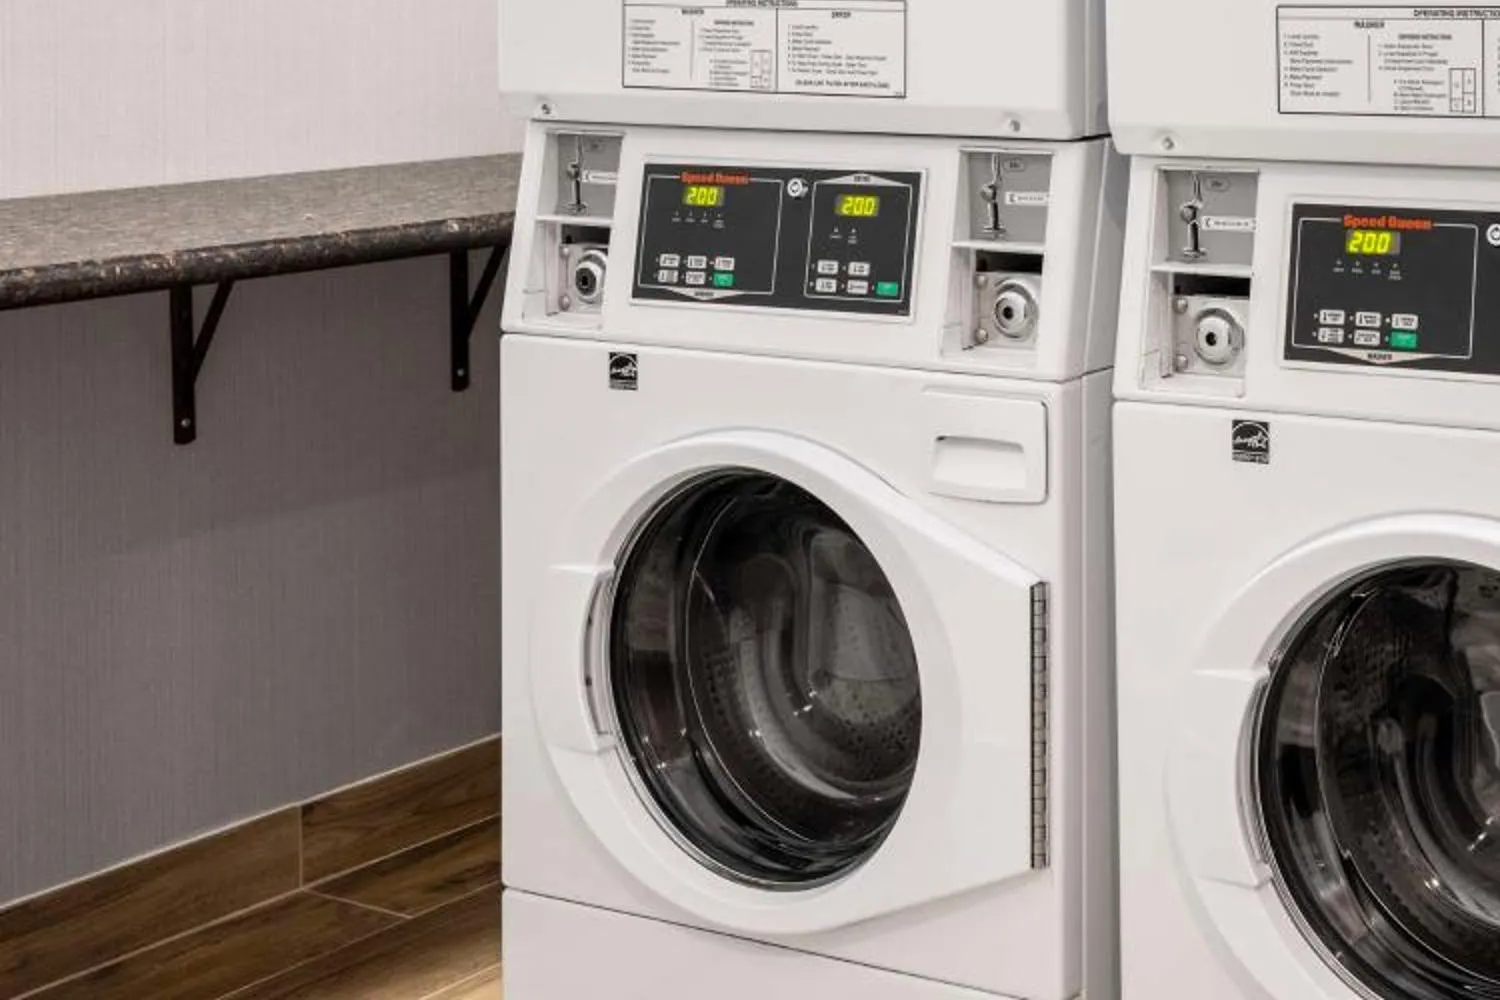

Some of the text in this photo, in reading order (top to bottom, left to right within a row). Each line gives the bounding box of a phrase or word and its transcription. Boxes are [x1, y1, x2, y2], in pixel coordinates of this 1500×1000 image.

[685, 186, 719, 206] 200
[841, 195, 876, 216] 200
[1343, 215, 1432, 231] Speed Queen
[1348, 231, 1392, 253] 200
